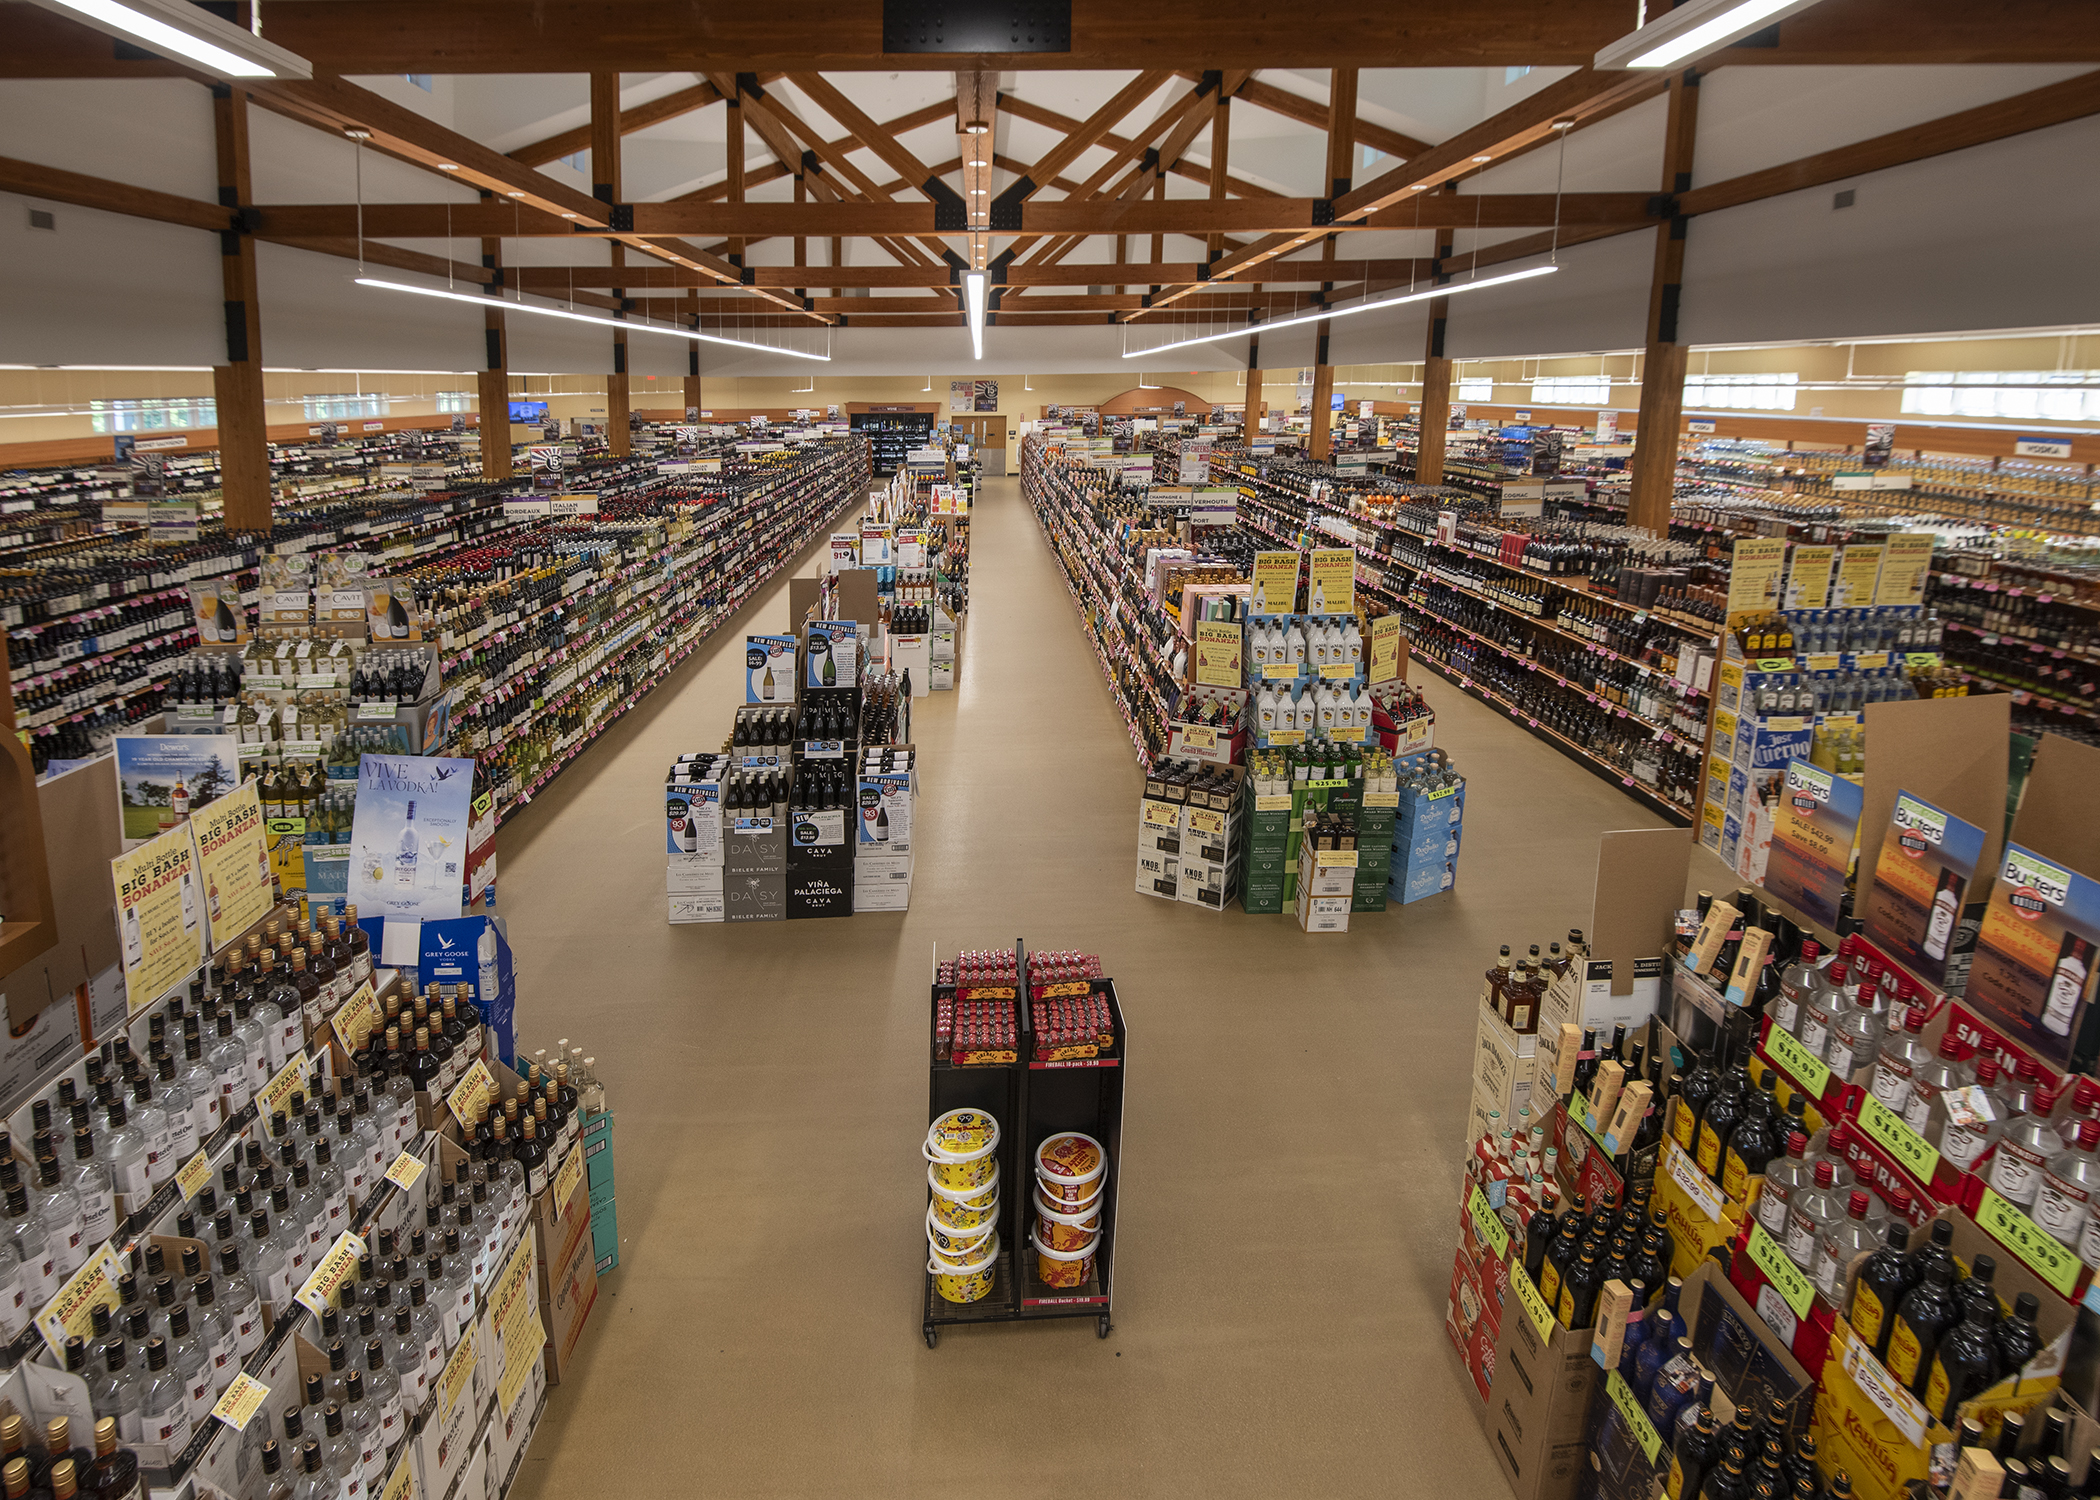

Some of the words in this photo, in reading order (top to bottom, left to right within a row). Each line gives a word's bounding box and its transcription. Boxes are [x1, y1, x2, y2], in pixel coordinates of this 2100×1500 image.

[833, 552, 843, 560] 91
[275, 595, 305, 605] CAVIT
[332, 593, 362, 604] CAVIT
[828, 623, 856, 634] ARRIVALS!
[766, 639, 795, 649] ARRIVALS!
[1199, 636, 1239, 645] BONANZA!
[159, 743, 190, 751] Dewar's
[1769, 733, 1792, 745] Jose
[1752, 738, 1811, 767] Cuervo
[364, 761, 409, 779] VIVE
[386, 780, 439, 795] VODKA!
[880, 778, 909, 787] ARRIVALS!
[1788, 771, 1829, 800] Busters
[687, 788, 718, 798] ARRIVALS!
[1794, 797, 1816, 810] OUTLET
[200, 826, 222, 846] BIG
[226, 804, 258, 835] BASH
[209, 812, 227, 829] Multi
[227, 803, 246, 819] Bottle
[672, 820, 684, 828] 93
[1896, 807, 1943, 841] Busters
[201, 814, 260, 857] BONANZA!
[1790, 817, 1810, 832] SALE!
[1810, 827, 1835, 845] $42.99
[731, 844, 779, 854] DAISY
[1791, 829, 1808, 844] Save
[1809, 839, 1829, 854] $8.00
[1901, 836, 1927, 850] OUTLET
[133, 861, 154, 877] Multi
[155, 847, 177, 867] Bottle
[1141, 859, 1159, 869] KNOB
[121, 873, 147, 897] BIG
[152, 849, 190, 878] BASH
[1184, 867, 1203, 879] KNOB
[2005, 862, 2065, 902] Busters
[121, 859, 191, 910] BONANZA!
[794, 888, 843, 896] PALACIEGA
[807, 879, 830, 888] VIÑA
[730, 891, 778, 901] DAISY
[2011, 896, 2045, 911] OUTLET
[1877, 906, 1895, 921] Code
[1992, 911, 2021, 933] SALE!
[2022, 926, 2061, 954] $18.99
[1993, 928, 2018, 948] Save
[1982, 972, 2005, 991] Code
[342, 1011, 353, 1025] BIG
[1481, 1036, 1493, 1052] JACK
[1776, 1030, 1794, 1045] SALE
[976, 1052, 998, 1061] FIREBALL
[1059, 1048, 1081, 1058] FIREBALL
[1778, 1041, 1816, 1080] $18.99
[223, 1080, 240, 1094] Ketel
[267, 1085, 280, 1100] BIG
[279, 1068, 299, 1086] BASH
[269, 1073, 301, 1107] BONANZA!
[457, 1090, 467, 1103] BIG
[466, 1073, 480, 1091] BASH
[1871, 1100, 1895, 1120] SALE
[1873, 1114, 1922, 1161] $18.99
[1675, 1165, 1700, 1197] $32.99
[1476, 1190, 1488, 1207] SALE
[1992, 1197, 2021, 1220] SALE
[1668, 1201, 1704, 1255] KAHLÚA
[1758, 1231, 1777, 1251] SALE
[1996, 1214, 2060, 1269] $18.99
[316, 1276, 330, 1292] BIG
[329, 1249, 350, 1273] BASH
[321, 1253, 356, 1298] BONANZA!
[556, 1276, 573, 1310] Captain
[571, 1241, 589, 1274] Morgan
[1516, 1265, 1530, 1285] SALE
[1759, 1246, 1800, 1295] $18.99
[56, 1297, 74, 1319] BIG
[75, 1266, 102, 1297] BASH
[494, 1295, 509, 1320] BIG
[511, 1247, 532, 1291] BASH
[60, 1272, 107, 1325] BONANZA!
[494, 1257, 533, 1334] BONANZA!
[1516, 1278, 1545, 1324] $27.99
[225, 1383, 249, 1415] BONANZA!
[231, 1381, 245, 1401] BASH
[1857, 1369, 1894, 1410] $32.99
[1844, 1407, 1898, 1484] KAHLÚA
